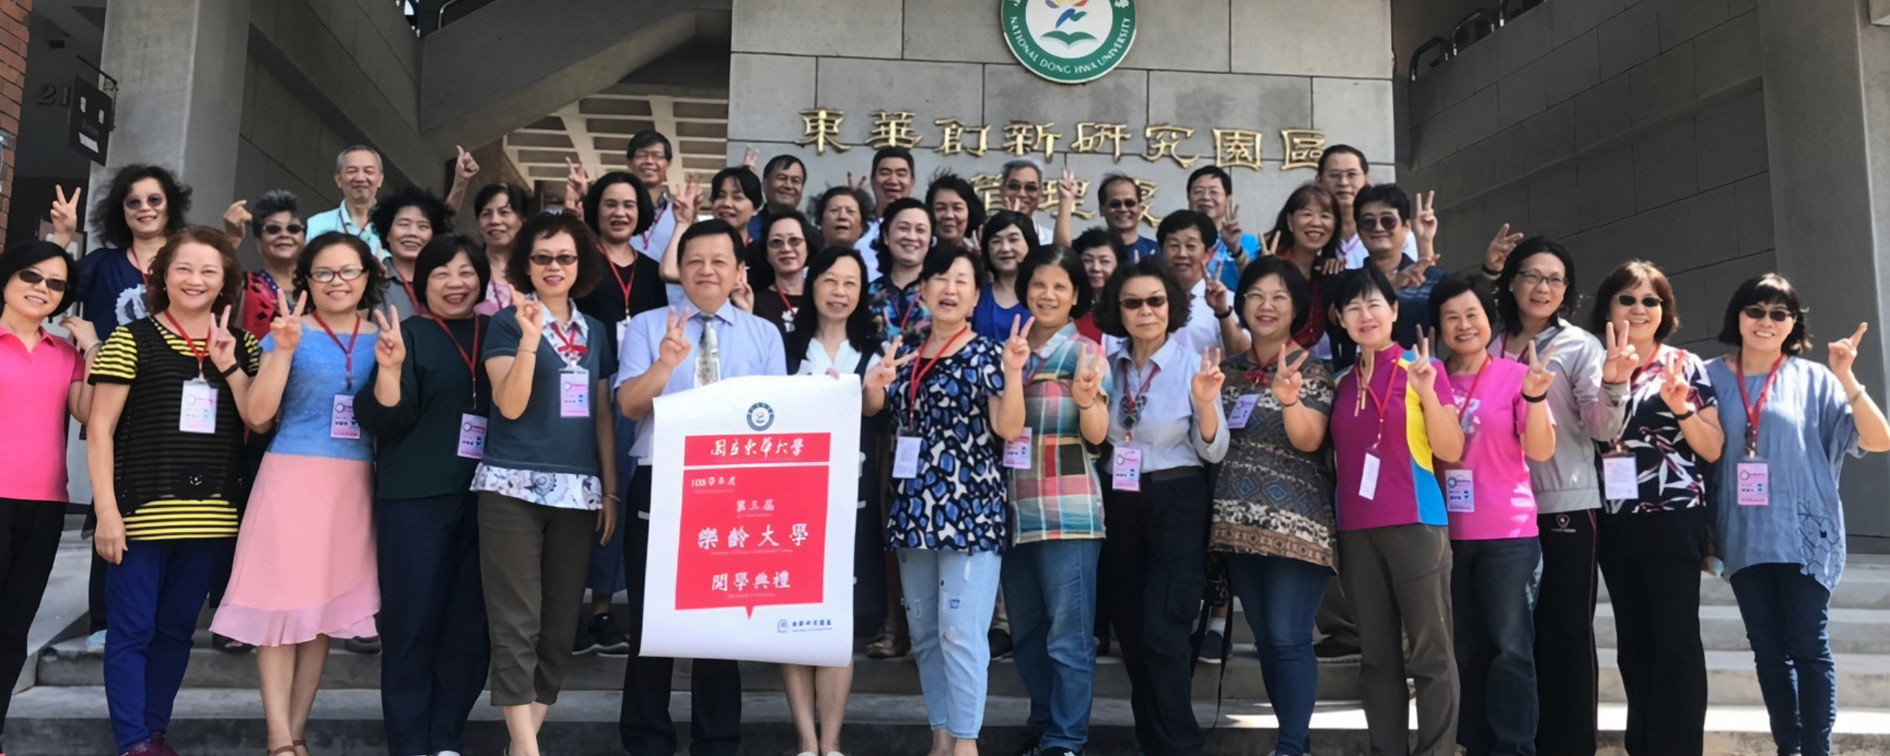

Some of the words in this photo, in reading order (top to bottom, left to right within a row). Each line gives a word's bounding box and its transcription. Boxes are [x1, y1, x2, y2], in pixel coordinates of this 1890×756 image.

[1010, 16, 1037, 62] NATIONAL
[1039, 58, 1071, 74] DONG
[1074, 63, 1098, 74] HWA
[1097, 17, 1131, 67] UNIVERSITY
[697, 523, 809, 550] 樂齡大學
